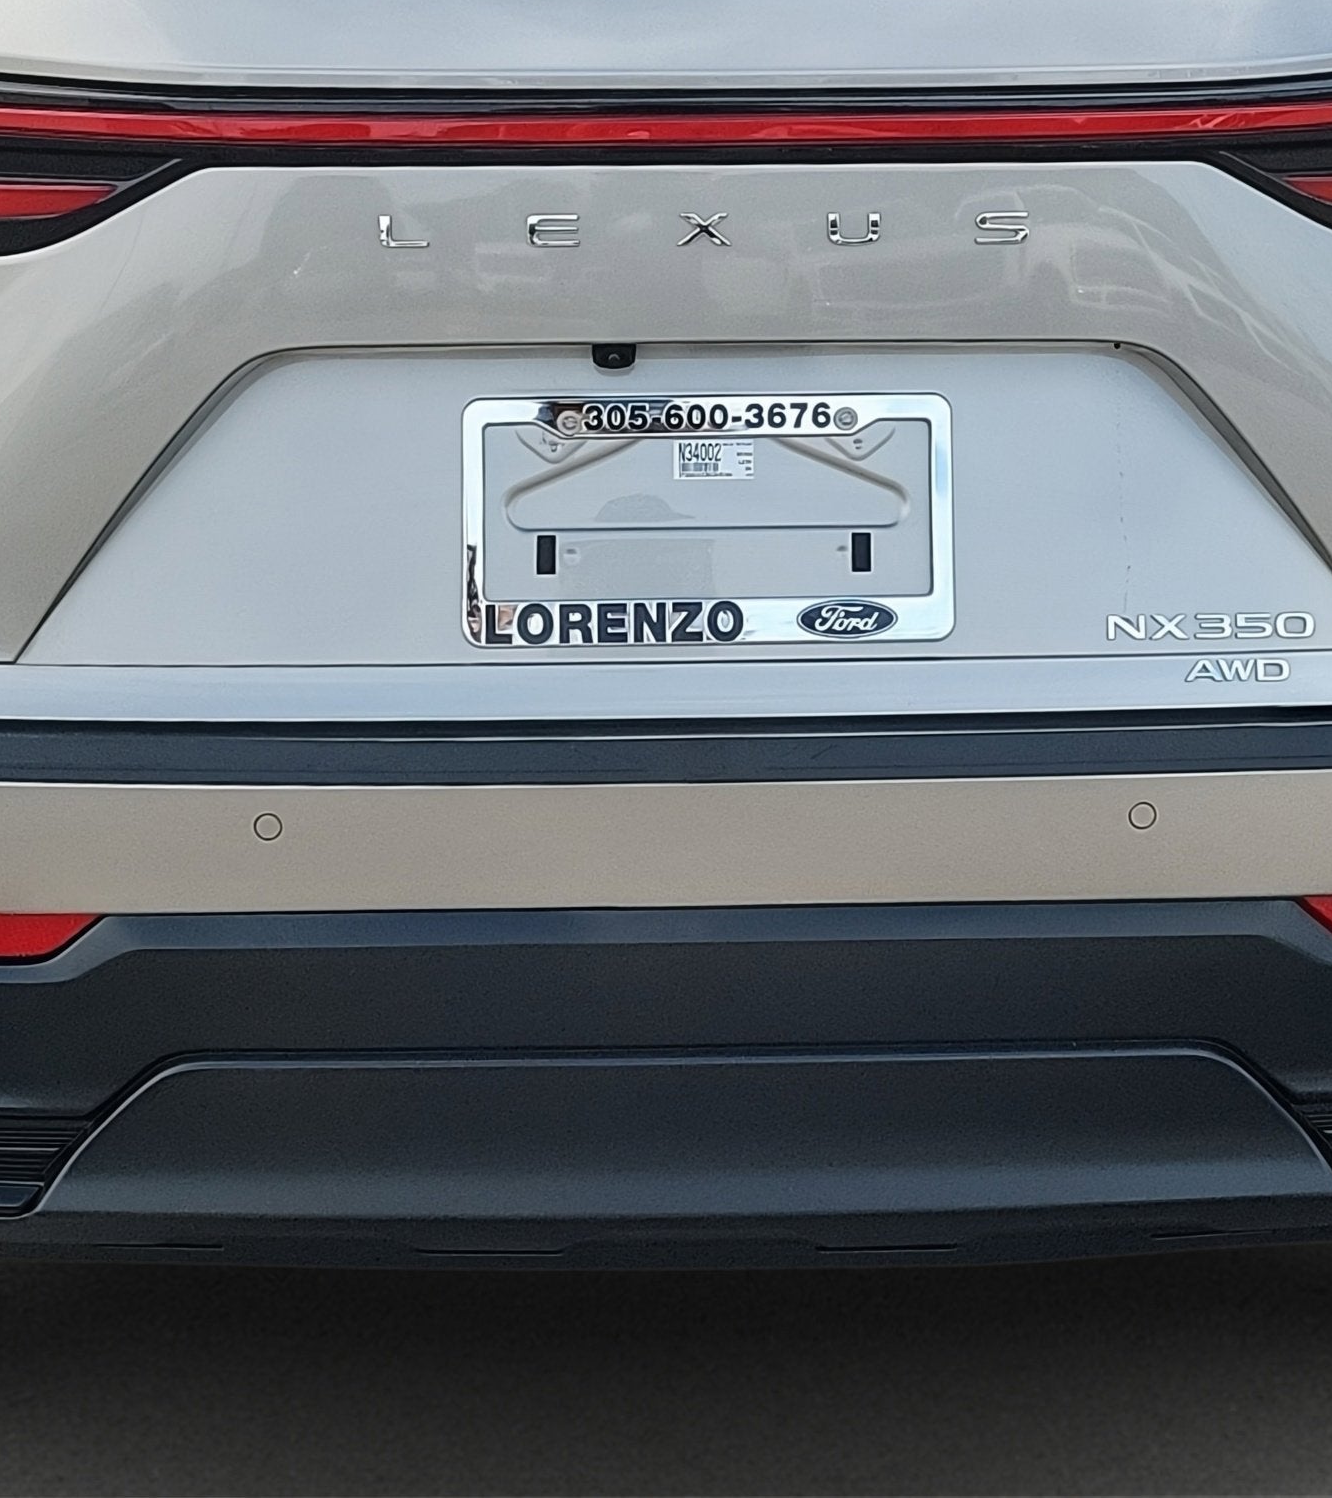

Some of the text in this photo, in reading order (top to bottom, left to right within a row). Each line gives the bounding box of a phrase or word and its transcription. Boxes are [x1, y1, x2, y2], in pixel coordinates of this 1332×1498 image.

[378, 212, 1030, 248] LEXUS
[583, 402, 832, 431] 305-600-3676
[678, 442, 722, 462] N34002
[484, 600, 879, 645] LORENZO Ford
[1184, 658, 1291, 683] AWD
